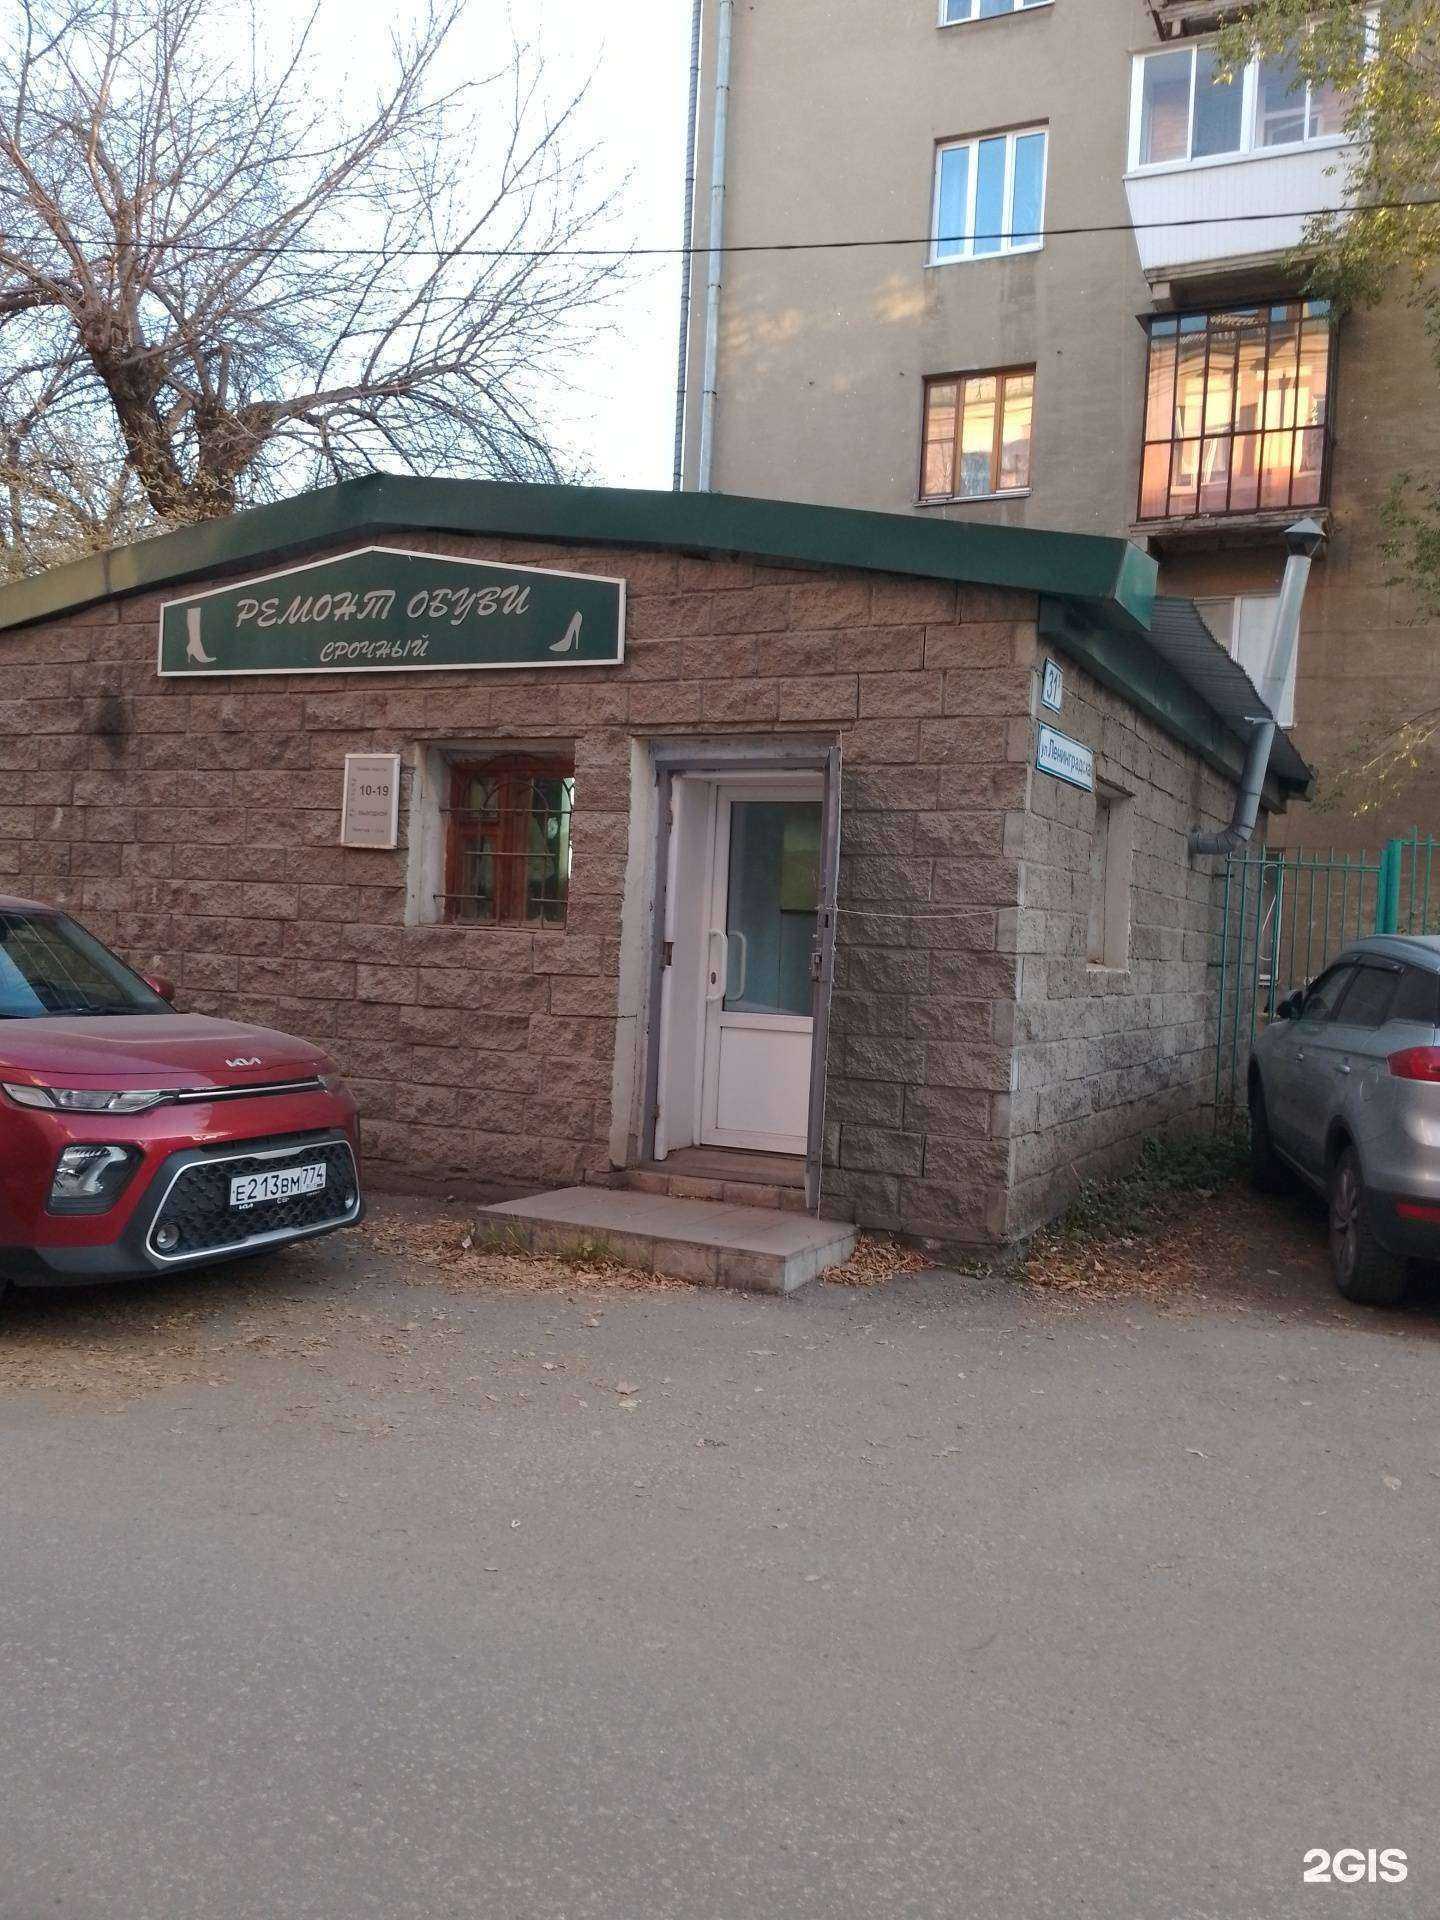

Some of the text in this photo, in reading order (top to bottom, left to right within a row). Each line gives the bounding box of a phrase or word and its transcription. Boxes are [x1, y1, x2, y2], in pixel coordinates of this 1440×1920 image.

[236, 584, 532, 628] РЕМОНТ ОБУВИ
[319, 633, 428, 662] СРОЧНЫЙ
[359, 785, 390, 797] 10-19
